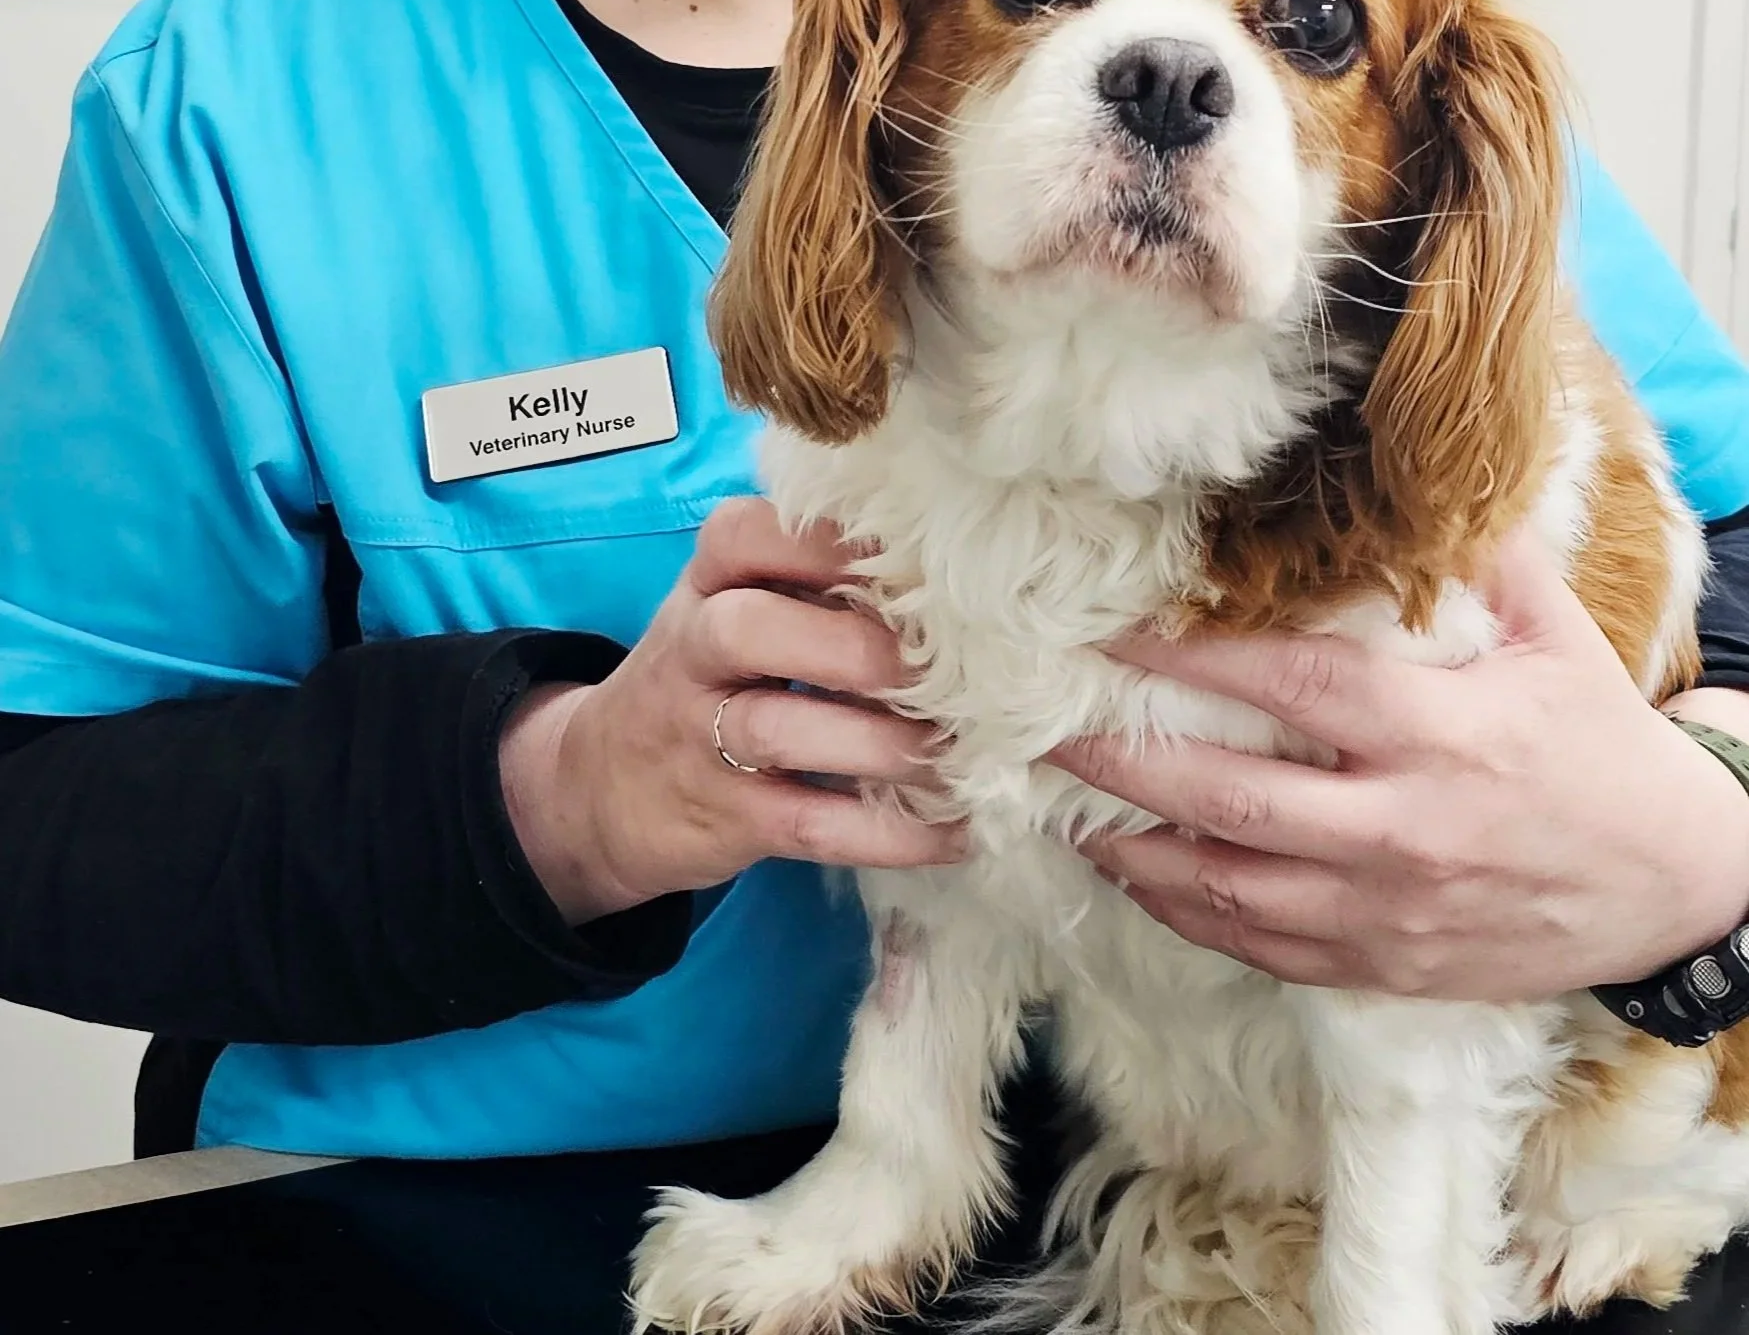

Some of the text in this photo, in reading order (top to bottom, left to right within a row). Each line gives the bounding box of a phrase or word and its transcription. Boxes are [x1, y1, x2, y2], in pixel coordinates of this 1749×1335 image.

[508, 386, 589, 422] Kelly
[468, 415, 636, 457] Veterinary Nurse
